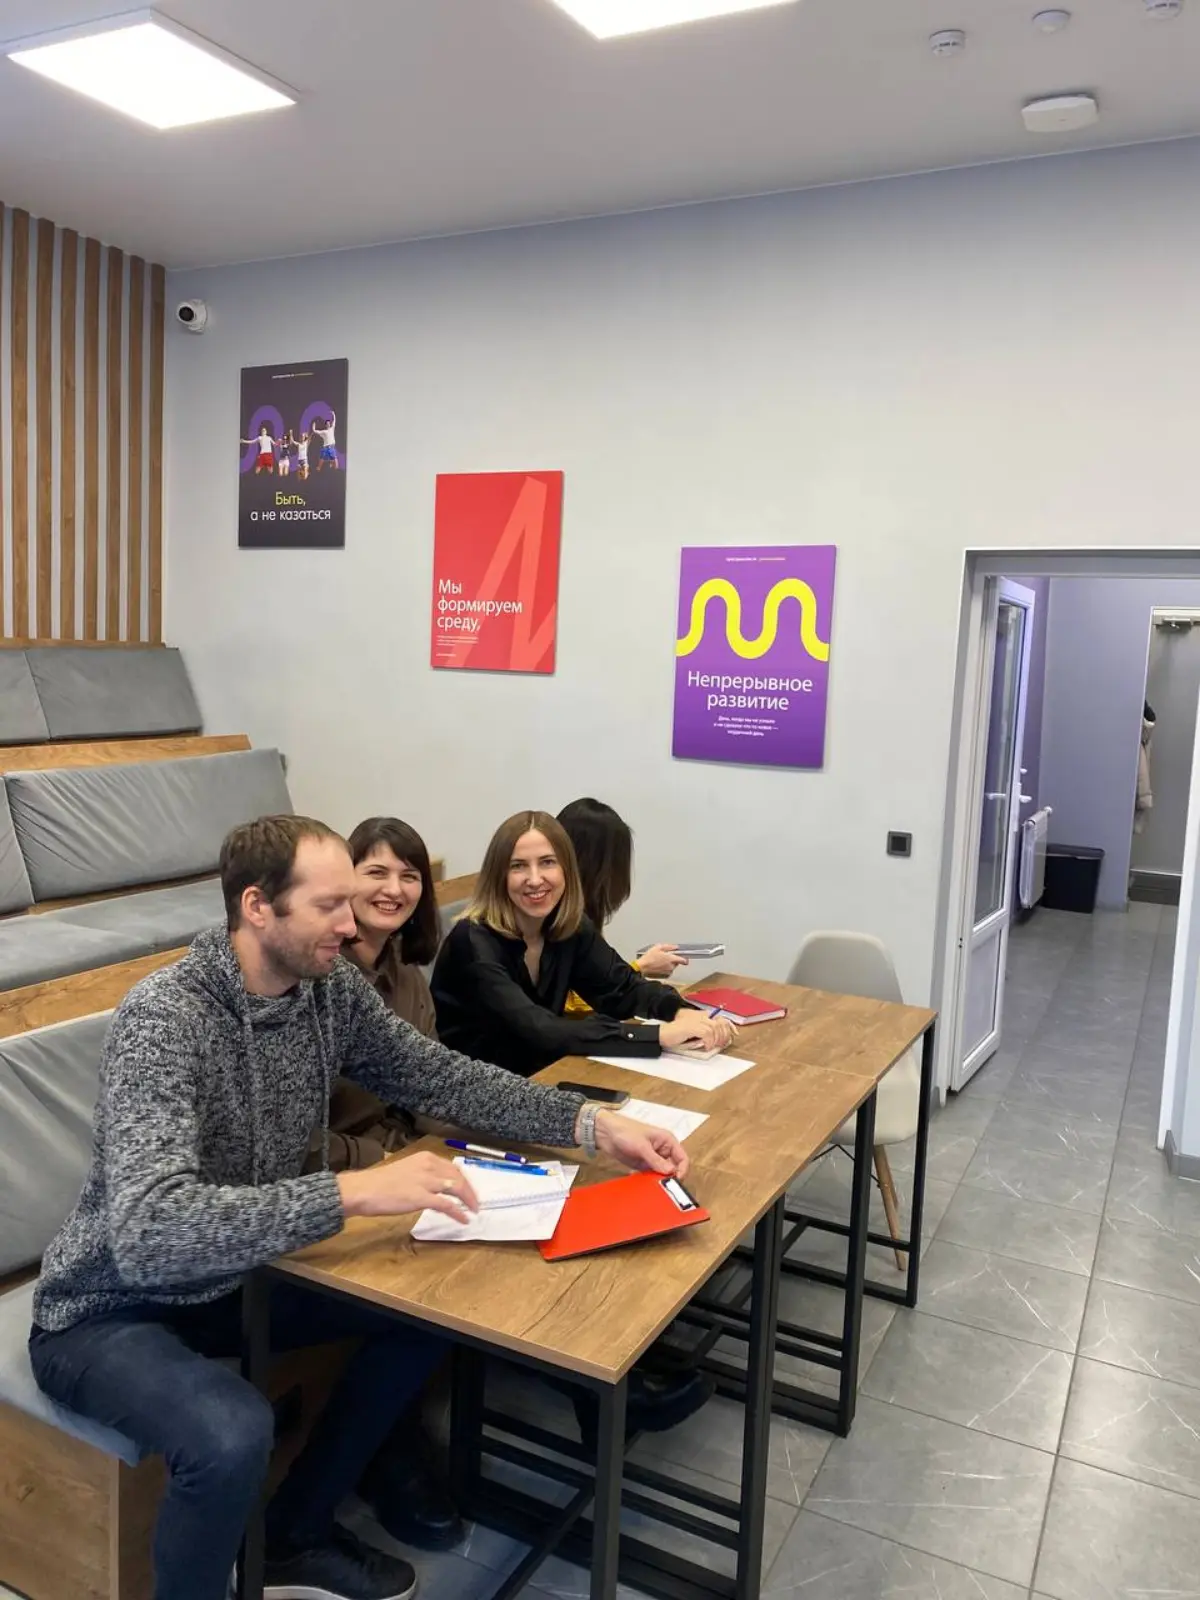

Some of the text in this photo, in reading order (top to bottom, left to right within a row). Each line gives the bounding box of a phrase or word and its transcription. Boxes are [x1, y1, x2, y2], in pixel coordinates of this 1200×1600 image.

[275, 491, 306, 506] Быть,
[250, 509, 331, 521] а не казаться
[438, 579, 462, 594] Мы
[437, 595, 523, 617] формируем
[436, 616, 480, 633] среду,
[688, 670, 813, 693] Непрерывное
[707, 693, 789, 711] развитие
